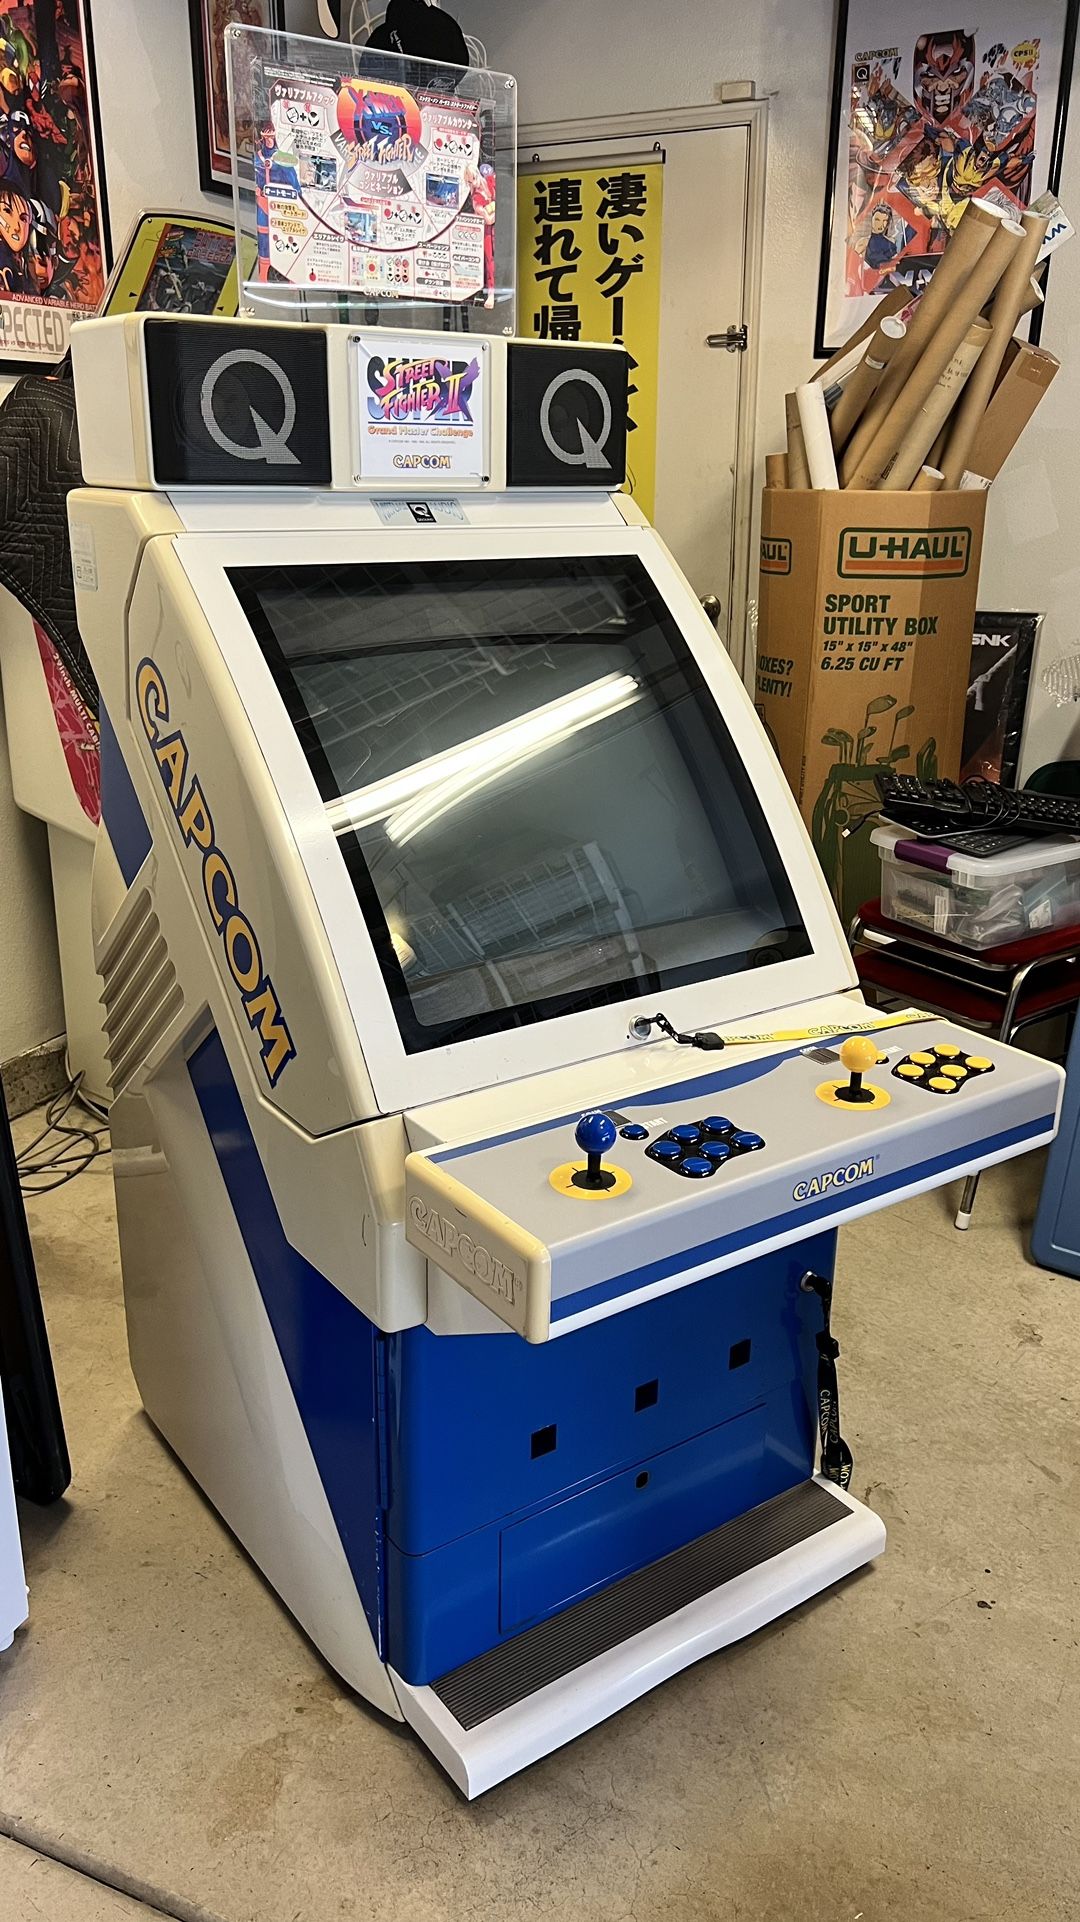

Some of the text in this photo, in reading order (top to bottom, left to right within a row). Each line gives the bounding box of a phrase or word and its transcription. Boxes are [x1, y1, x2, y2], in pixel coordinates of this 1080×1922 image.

[855, 47, 899, 62] CAPCOM
[12, 294, 43, 305] ADVANCED
[43, 297, 70, 308] VARIABLE
[376, 357, 449, 397] STREET
[201, 348, 301, 464] Q
[380, 378, 441, 420] FIGHTER
[539, 368, 612, 469] Q
[367, 425, 474, 439] Grand Master Challenge
[392, 454, 452, 469] CAPCOM
[849, 535, 963, 560] U-HAUL
[824, 594, 891, 614] SPORT
[823, 616, 938, 636] UTILITY BOX
[823, 640, 844, 652] 15"
[857, 640, 879, 652] 15"
[890, 640, 913, 652] 48"
[820, 657, 904, 672] 6.25 CU FT
[70, 690, 88, 721] MULTI
[135, 656, 298, 1089] CAPCOM
[807, 1022, 876, 1036] CAPCOM
[793, 1156, 874, 1201] CAPCOM
[409, 1196, 515, 1305] CAPCOM
